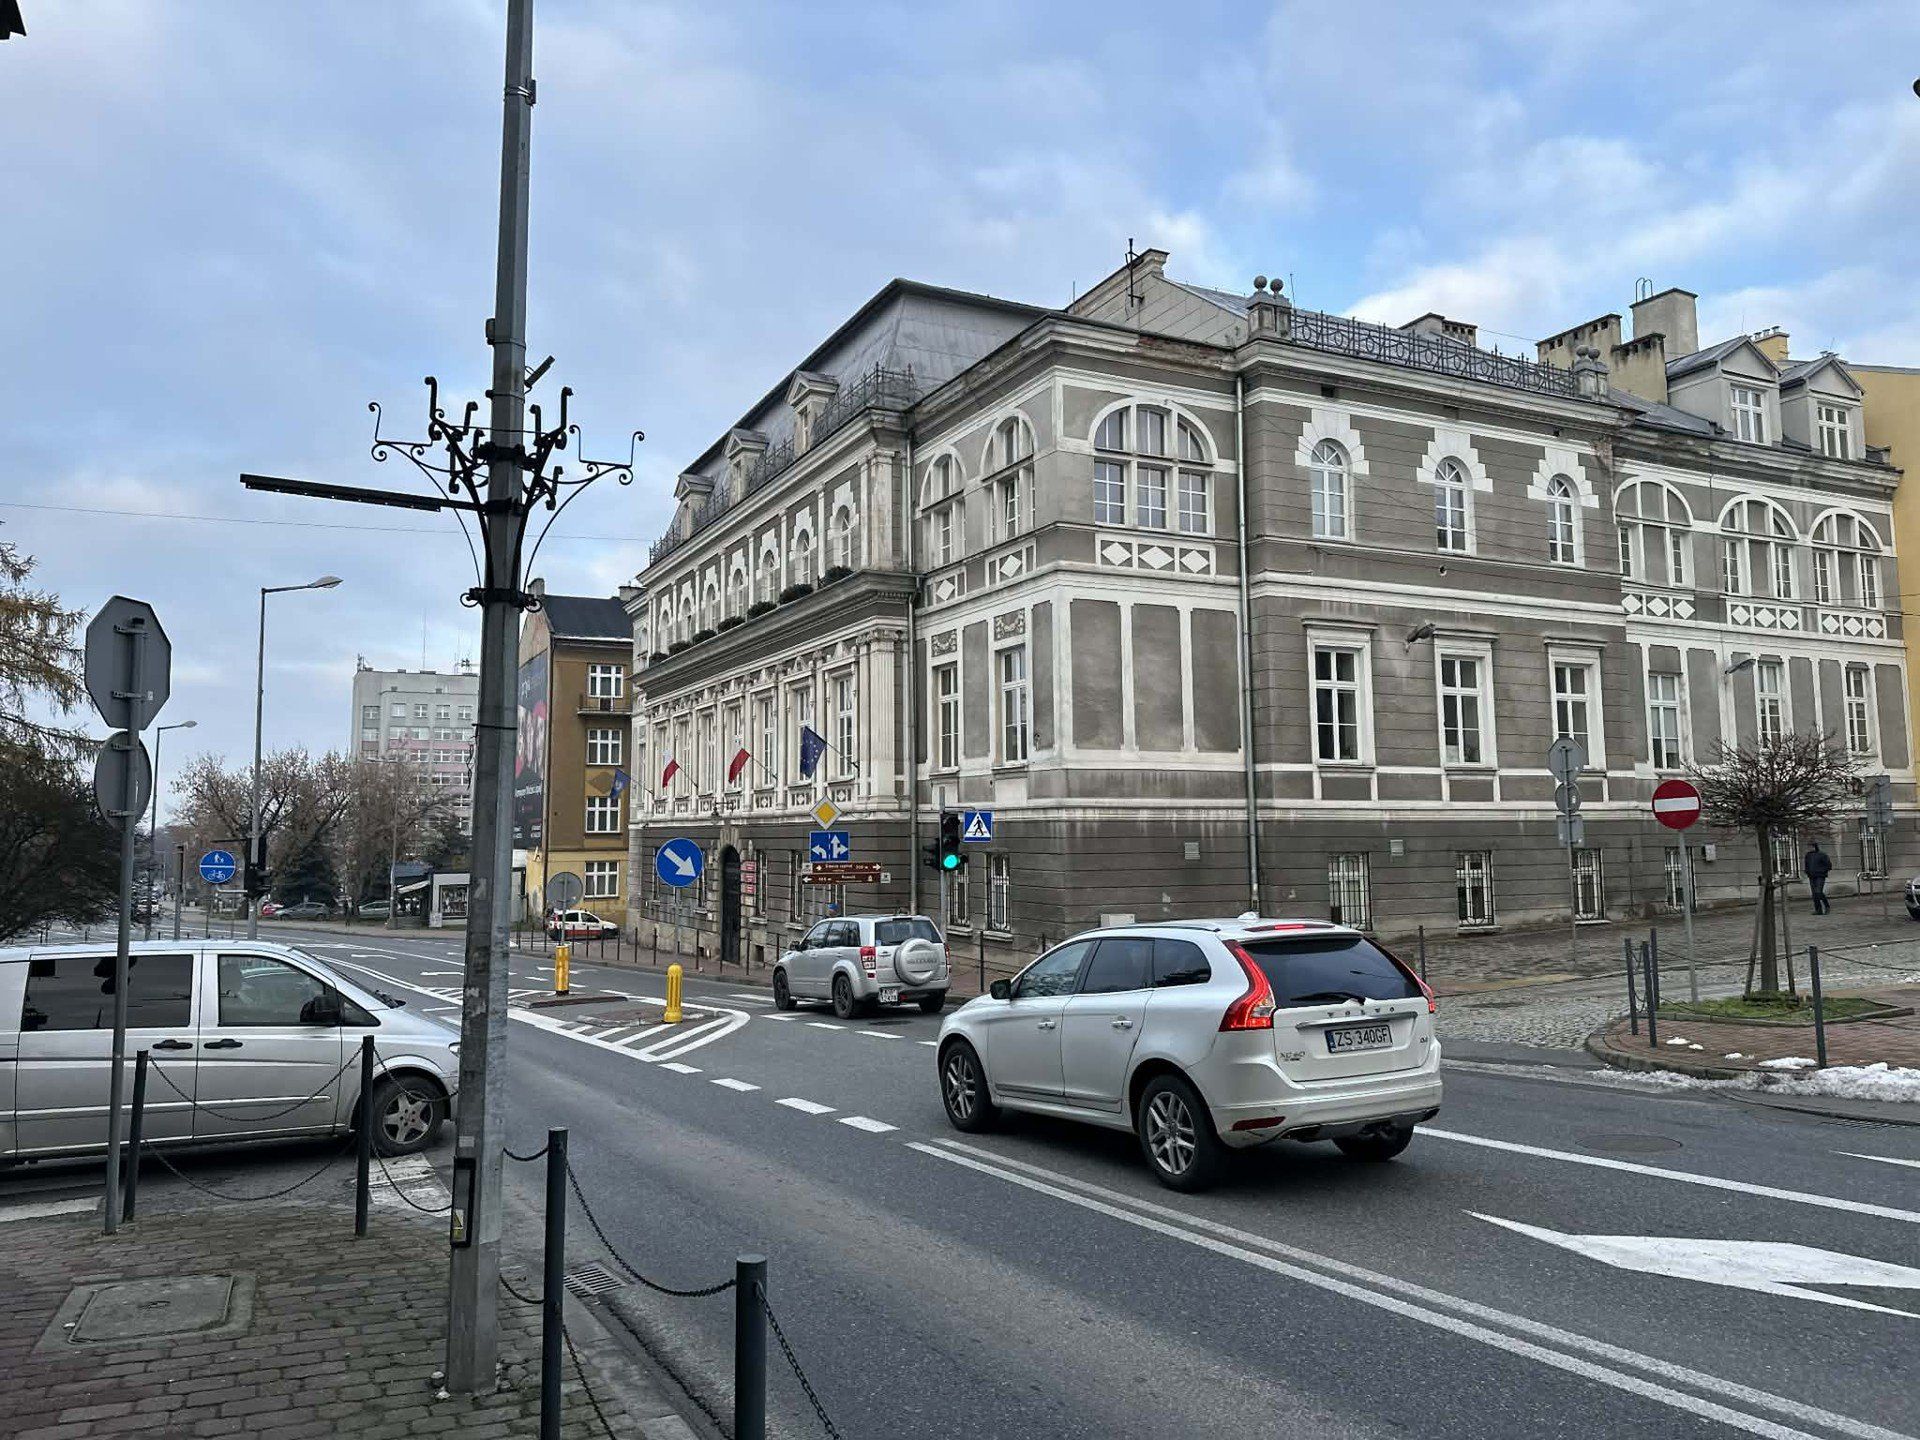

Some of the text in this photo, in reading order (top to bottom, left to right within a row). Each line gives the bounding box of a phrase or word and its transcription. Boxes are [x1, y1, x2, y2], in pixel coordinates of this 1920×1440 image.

[1327, 1006, 1395, 1018] VOLVO
[1335, 1027, 1387, 1047] ZS 340GF
